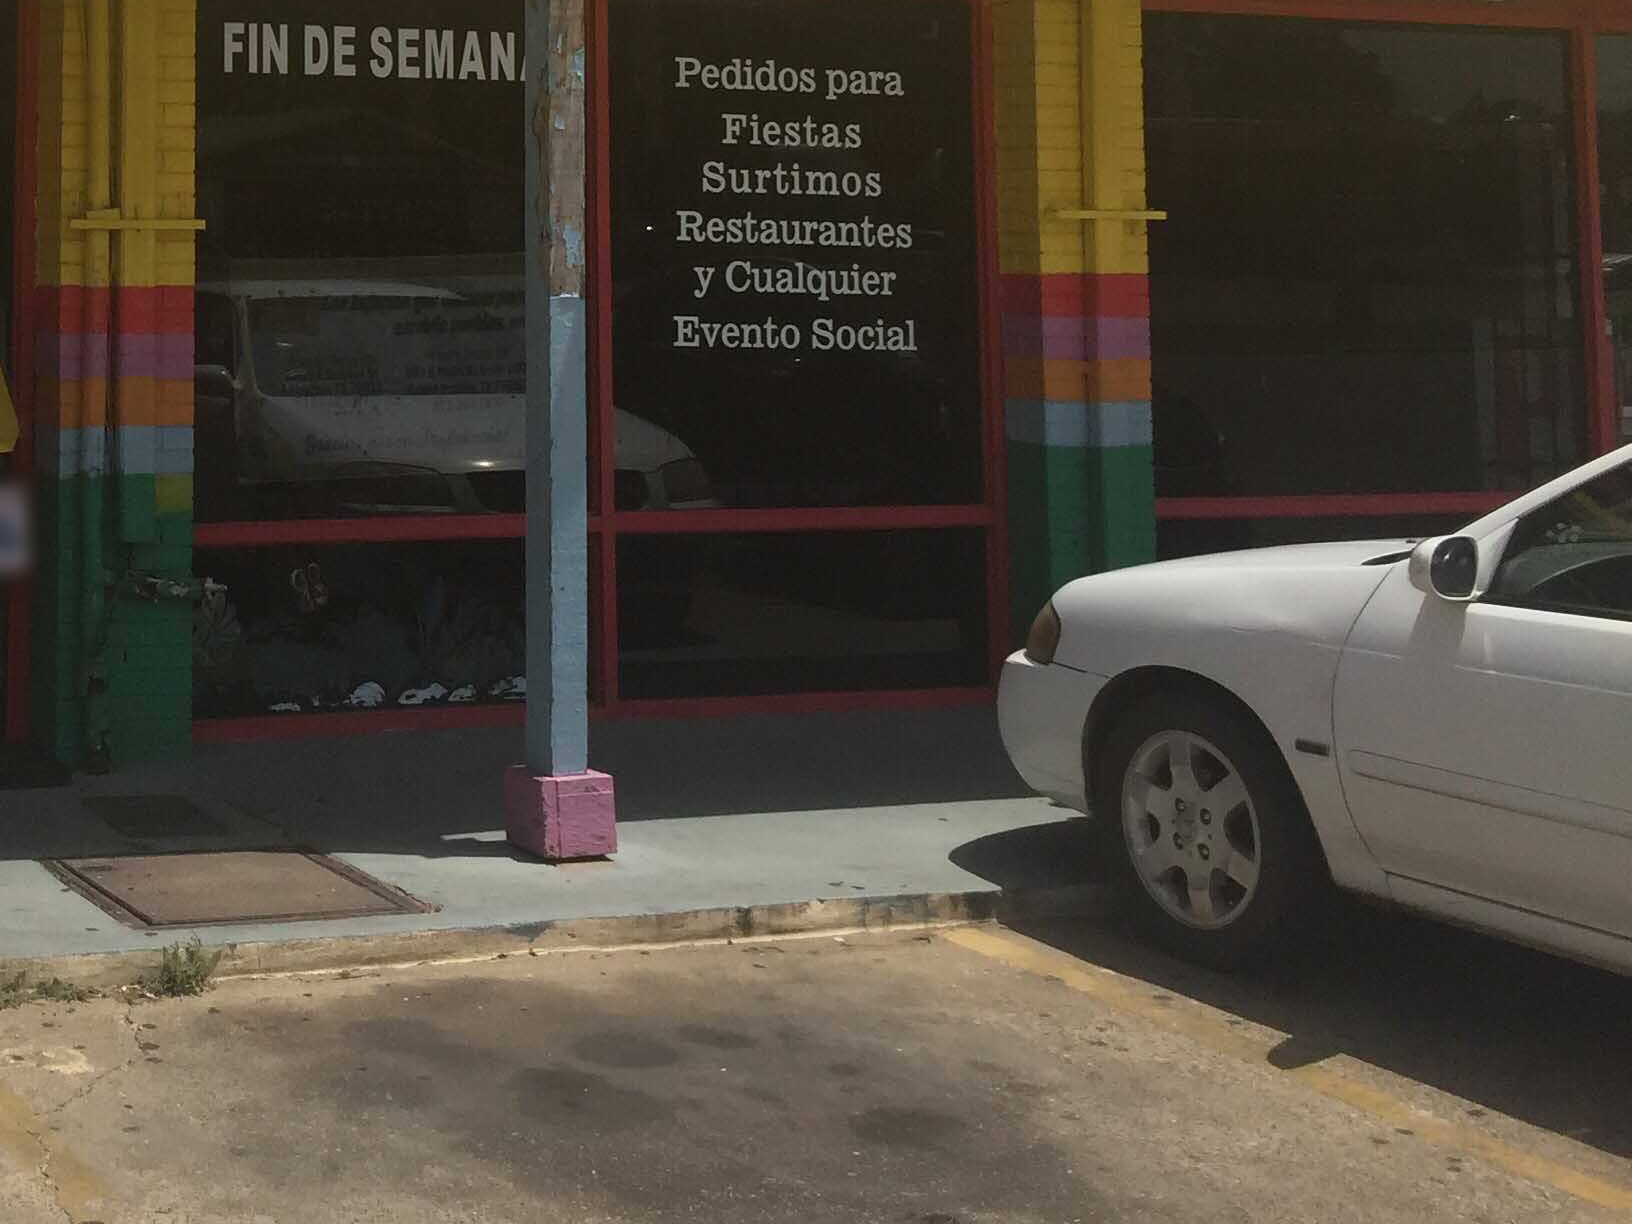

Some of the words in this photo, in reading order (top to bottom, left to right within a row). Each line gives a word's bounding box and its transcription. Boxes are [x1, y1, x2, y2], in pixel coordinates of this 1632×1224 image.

[222, 22, 290, 75] FIN
[303, 24, 357, 77] DE
[369, 25, 527, 82] SEMAN
[674, 56, 817, 94] Pedidos
[825, 69, 905, 100] para
[720, 113, 863, 149] Fiestas
[701, 161, 883, 198] Surtimos
[675, 210, 913, 250] Restaurantes
[693, 266, 715, 298] y
[725, 260, 897, 301] Cualquier
[672, 315, 801, 350] Evento
[811, 318, 918, 352] Social
